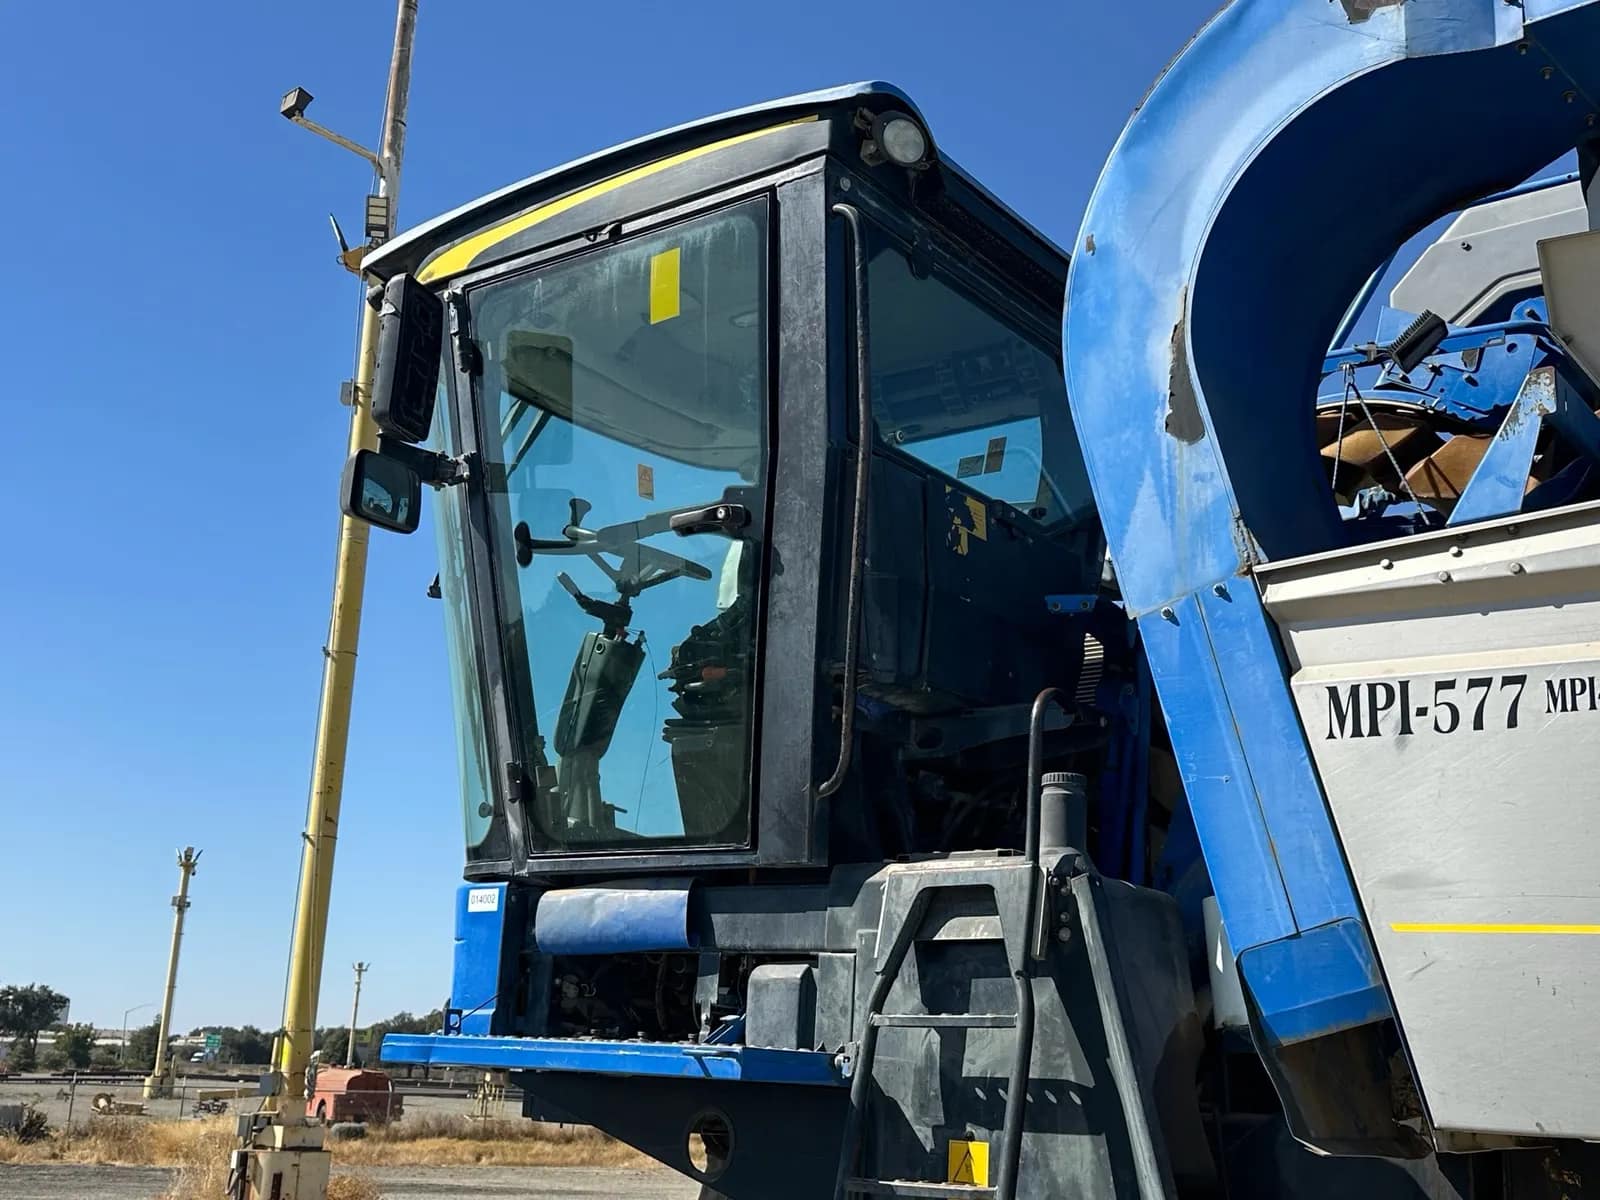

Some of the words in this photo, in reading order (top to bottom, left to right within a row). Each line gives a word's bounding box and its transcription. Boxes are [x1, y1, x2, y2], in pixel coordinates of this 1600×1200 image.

[1325, 674, 1528, 740] MPI-577
[1544, 676, 1600, 713] MPI
[470, 893, 496, 905] 014002
